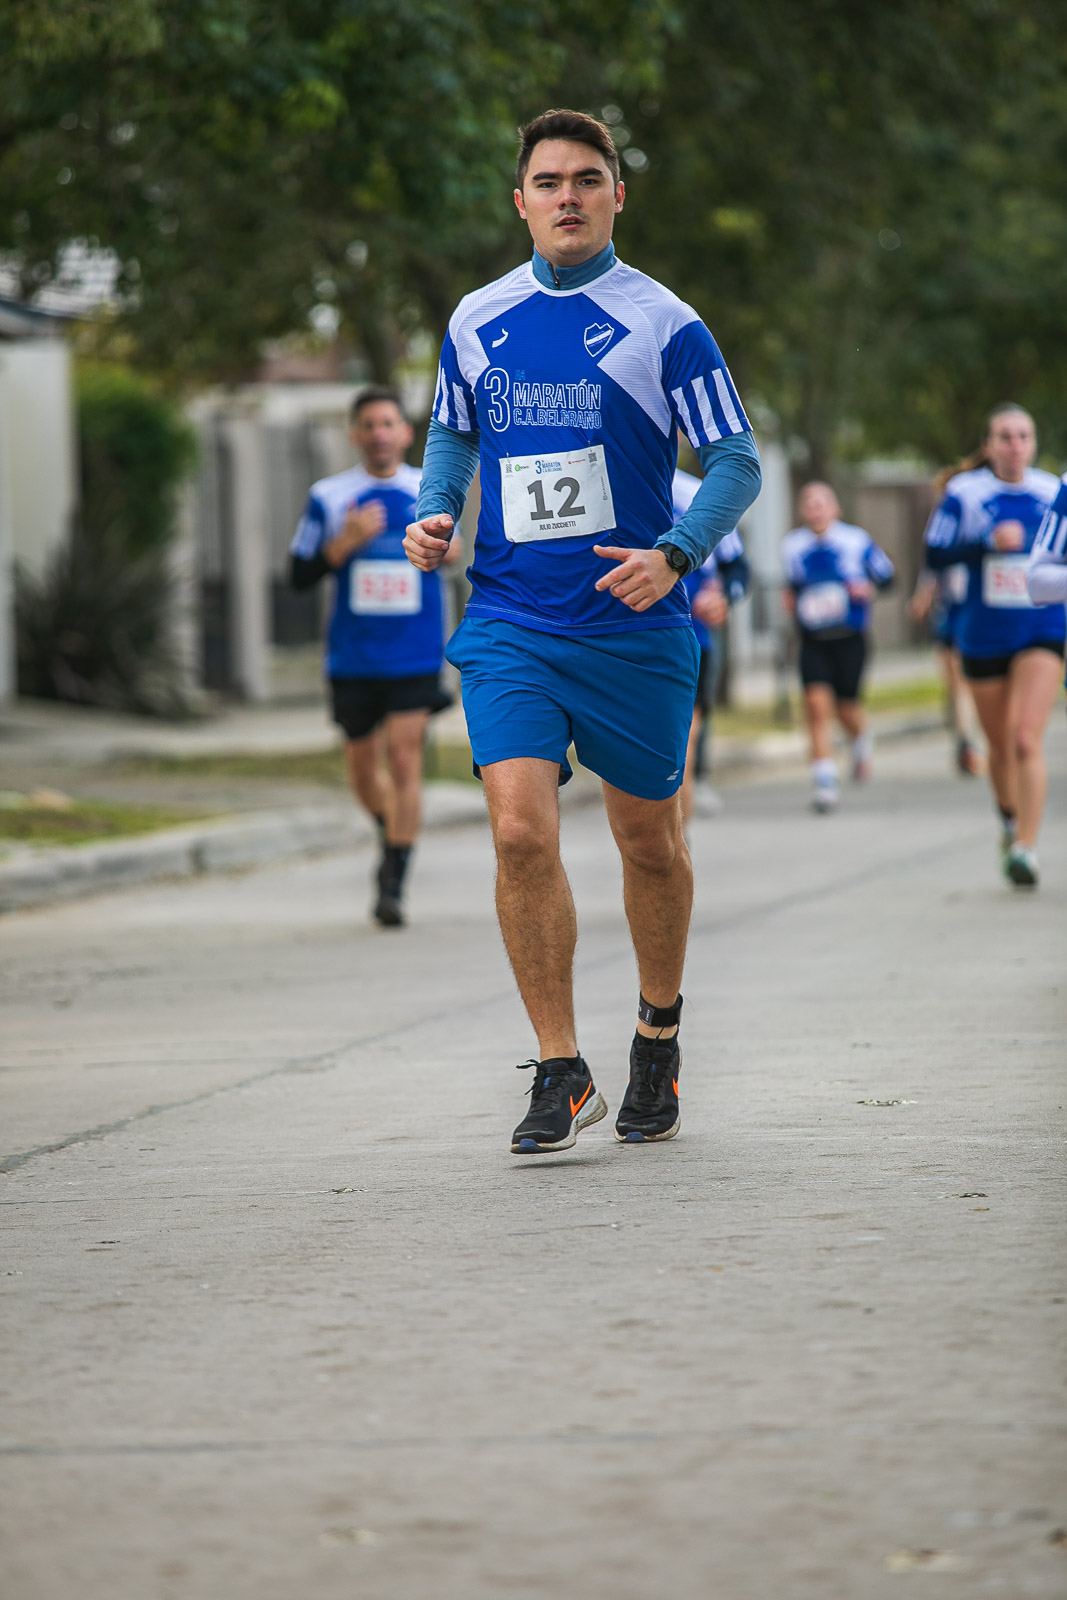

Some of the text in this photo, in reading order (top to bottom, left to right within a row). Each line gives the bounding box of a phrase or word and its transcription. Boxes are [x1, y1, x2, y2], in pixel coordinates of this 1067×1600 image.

[485, 367, 511, 432] 3
[513, 379, 602, 410] MARATÓN
[513, 408, 602, 430] C.A.BELGRANO
[535, 460, 542, 474] 3
[527, 476, 586, 521] 12
[539, 523, 551, 531] JULIO
